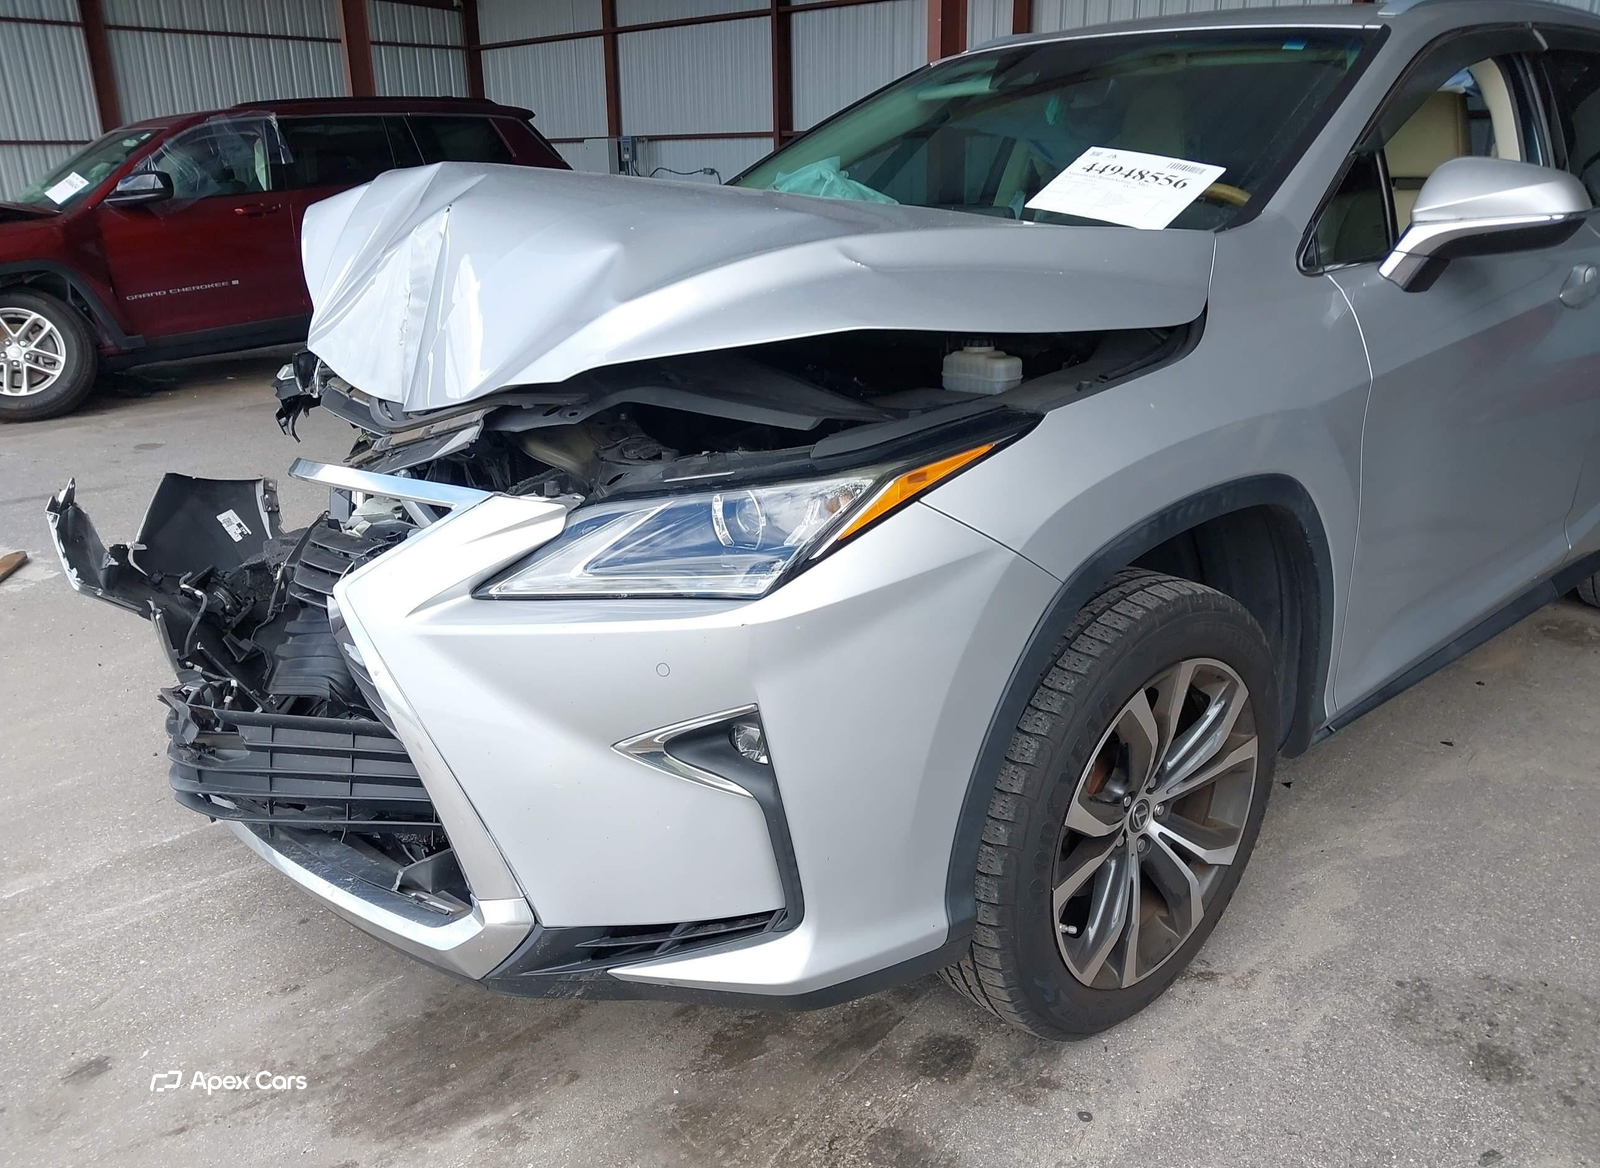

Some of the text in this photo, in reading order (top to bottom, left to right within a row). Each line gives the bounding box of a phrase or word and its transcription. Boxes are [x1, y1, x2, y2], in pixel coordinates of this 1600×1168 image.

[1082, 161, 1192, 190] 44948556
[126, 290, 166, 300] GRAND
[169, 281, 229, 294] CHEROKEE
